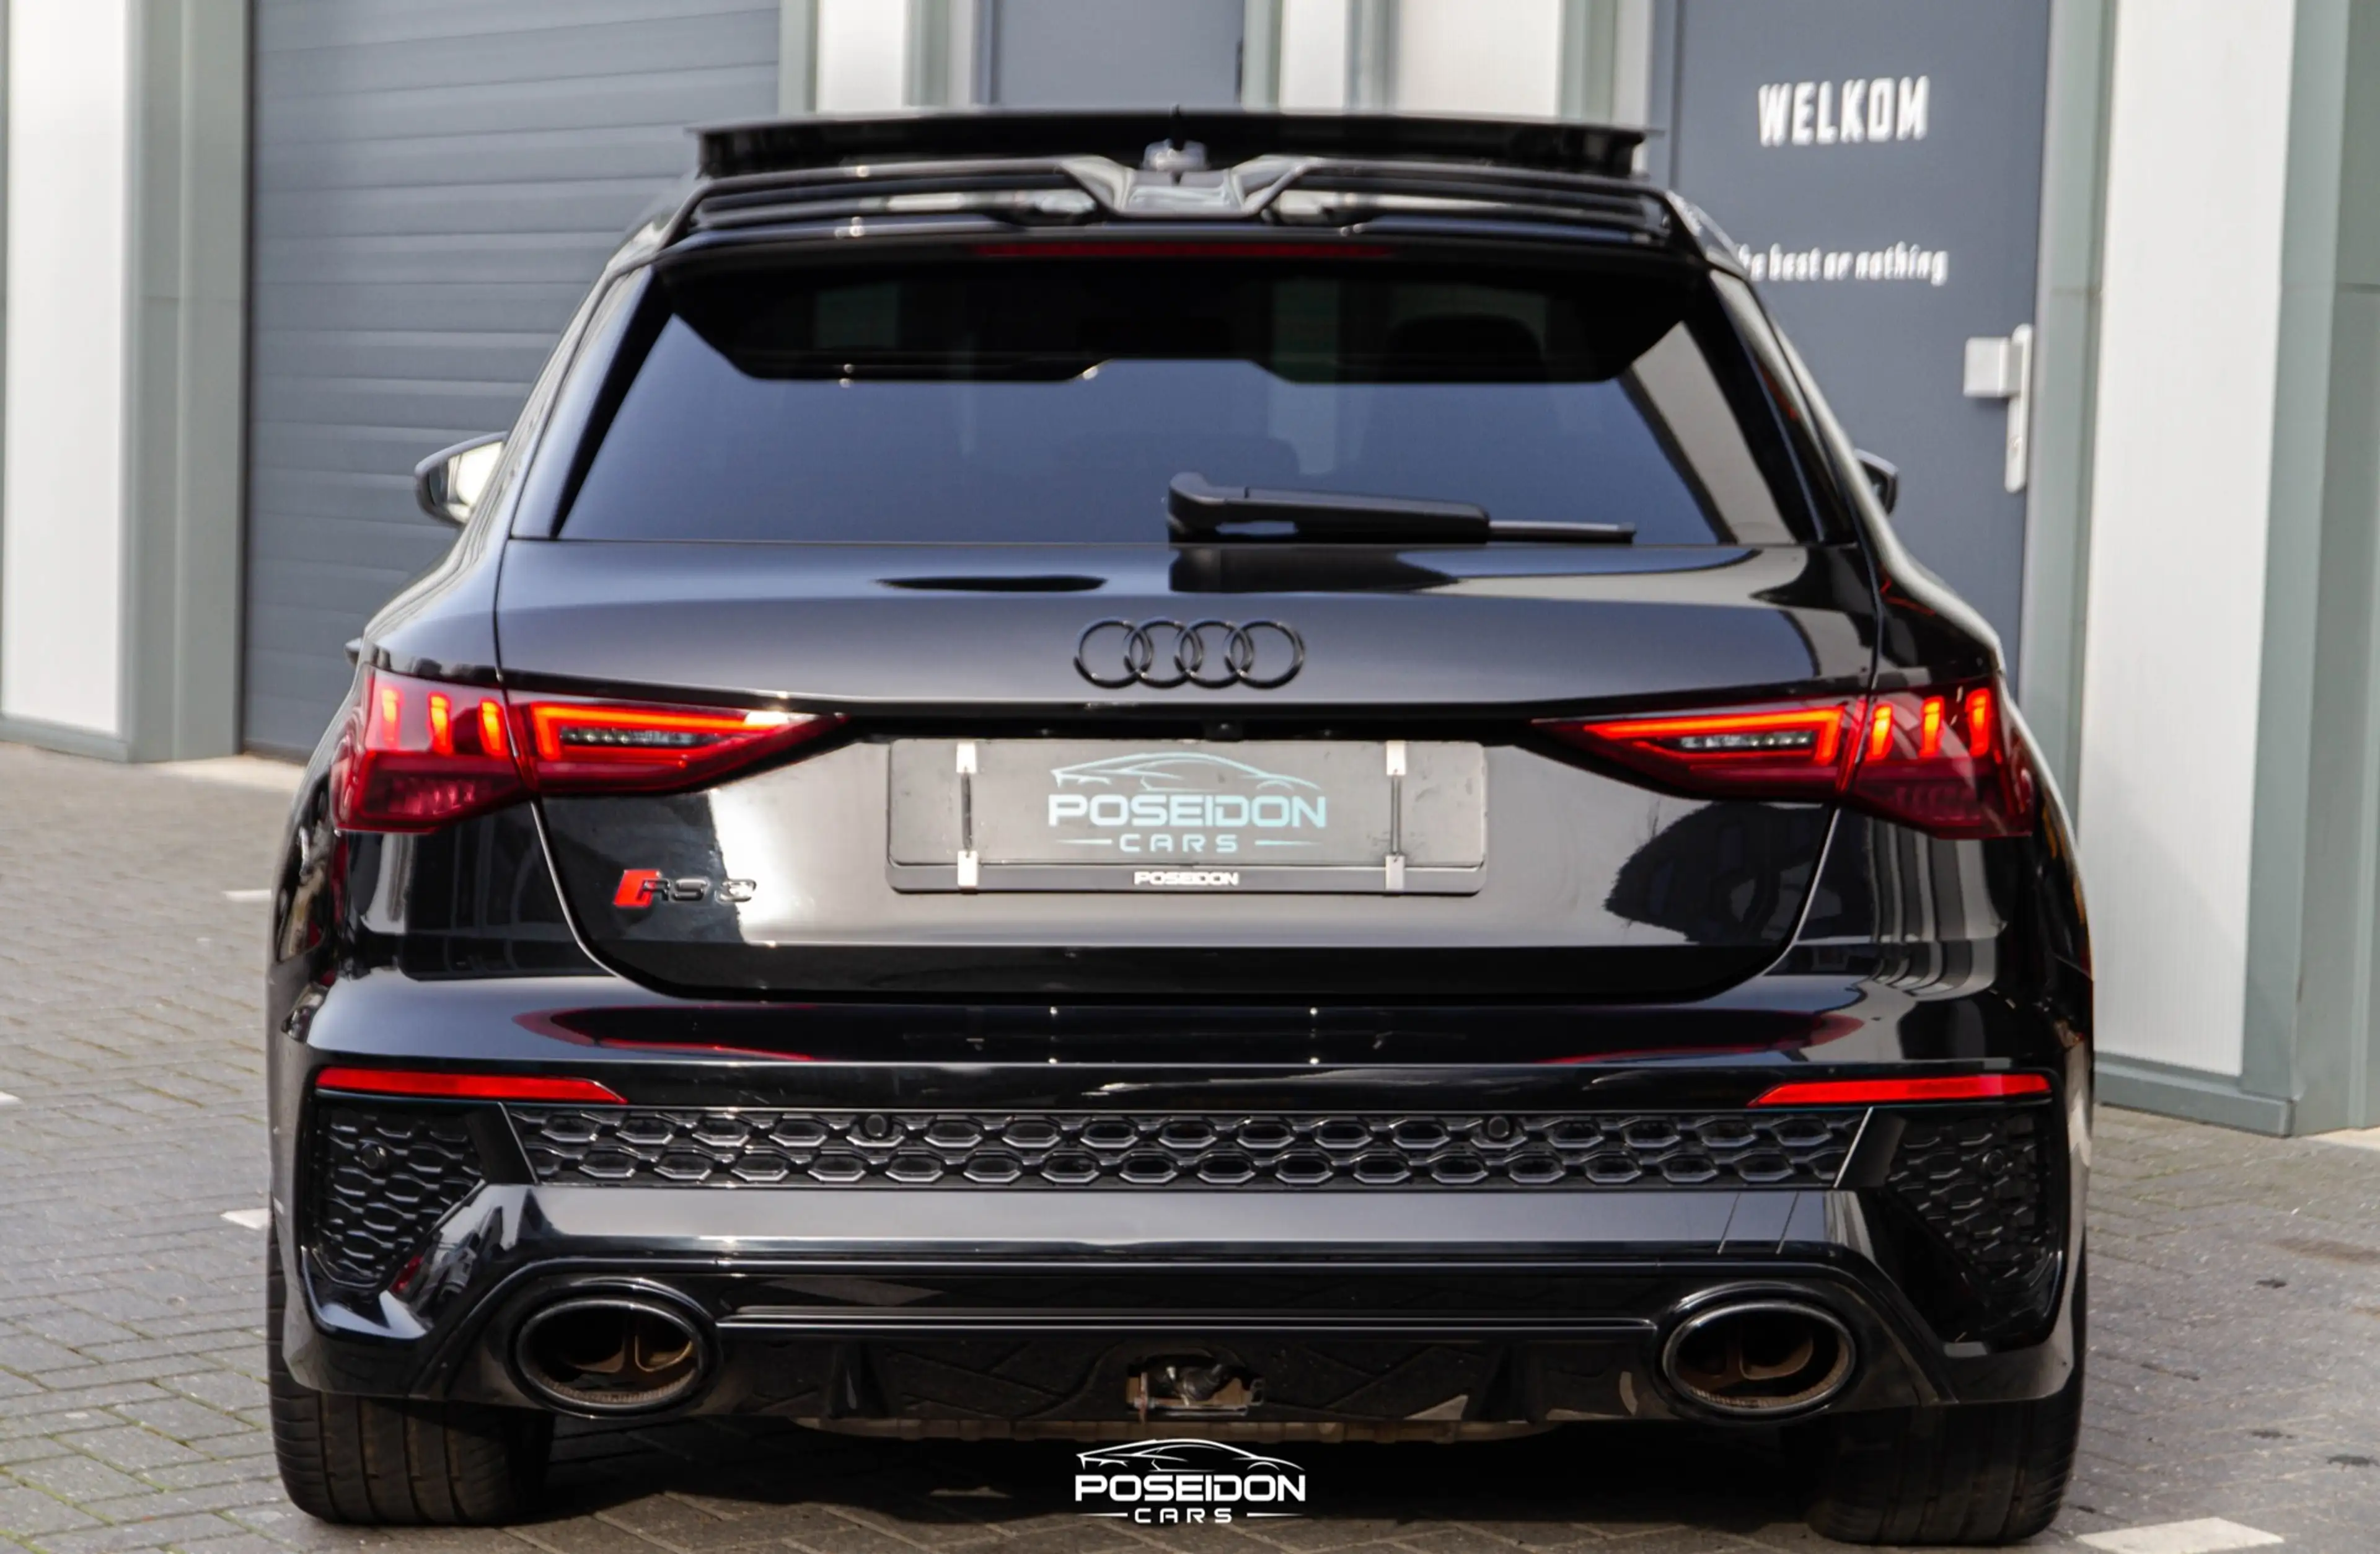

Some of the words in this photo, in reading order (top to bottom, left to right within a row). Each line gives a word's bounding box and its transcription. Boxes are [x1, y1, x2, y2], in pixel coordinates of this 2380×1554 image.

[1758, 76, 1929, 146] WELKOM
[1738, 244, 1768, 281] he
[1769, 243, 1821, 281] best
[1823, 252, 1853, 281] or
[1855, 241, 1948, 286] nothing
[1048, 794, 1326, 828] POSEIDON
[1119, 834, 1238, 853] CARS
[1134, 872, 1238, 886] POSEIDON
